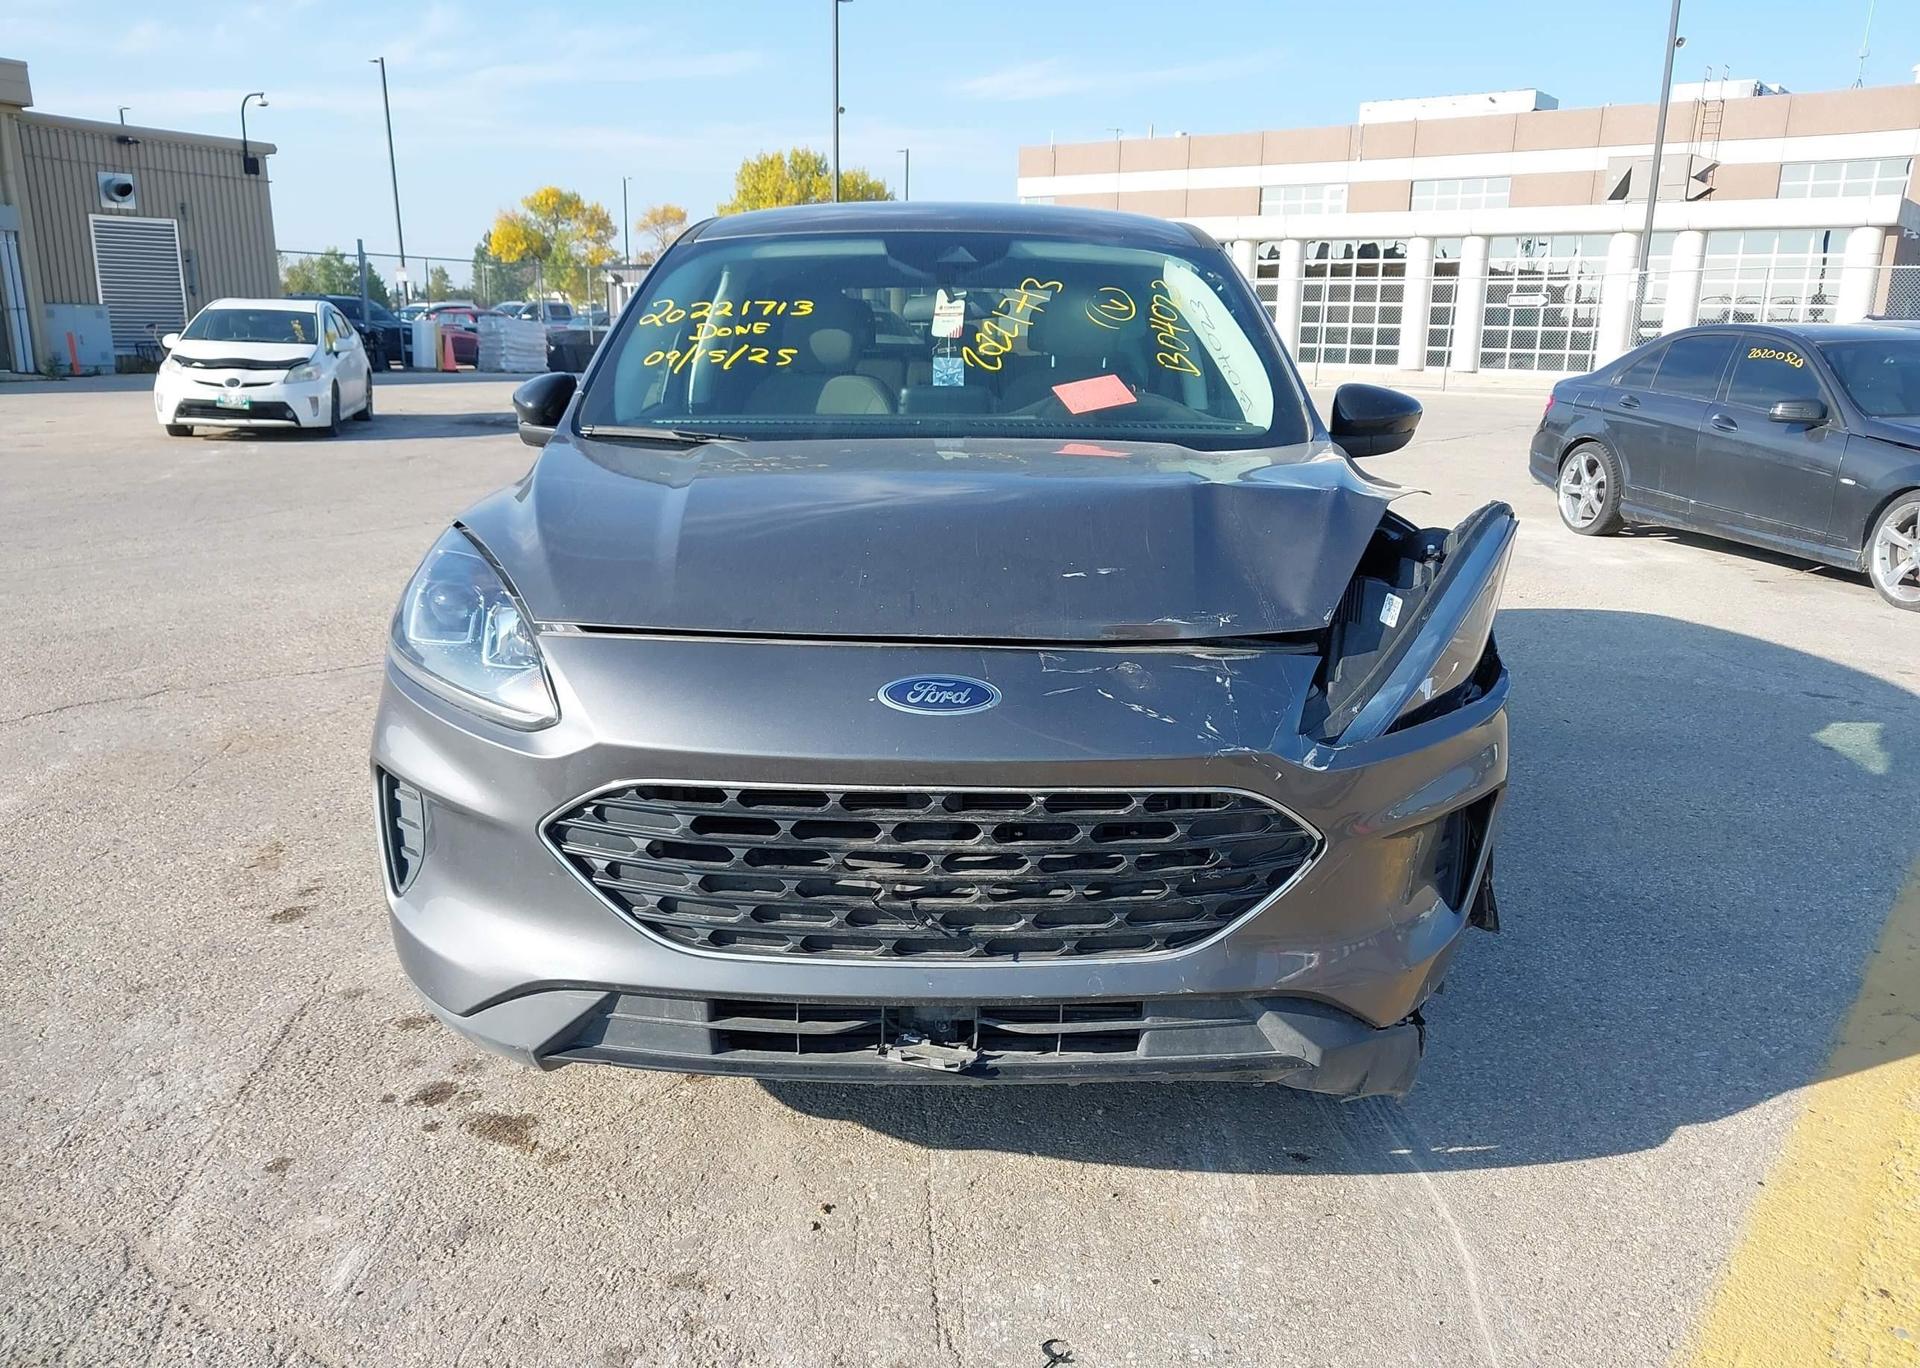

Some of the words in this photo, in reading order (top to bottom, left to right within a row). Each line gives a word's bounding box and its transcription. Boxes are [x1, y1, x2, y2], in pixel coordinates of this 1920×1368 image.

[639, 299, 814, 327] 20221713
[643, 343, 799, 375] 09/15/25
[906, 680, 972, 705] Ford
